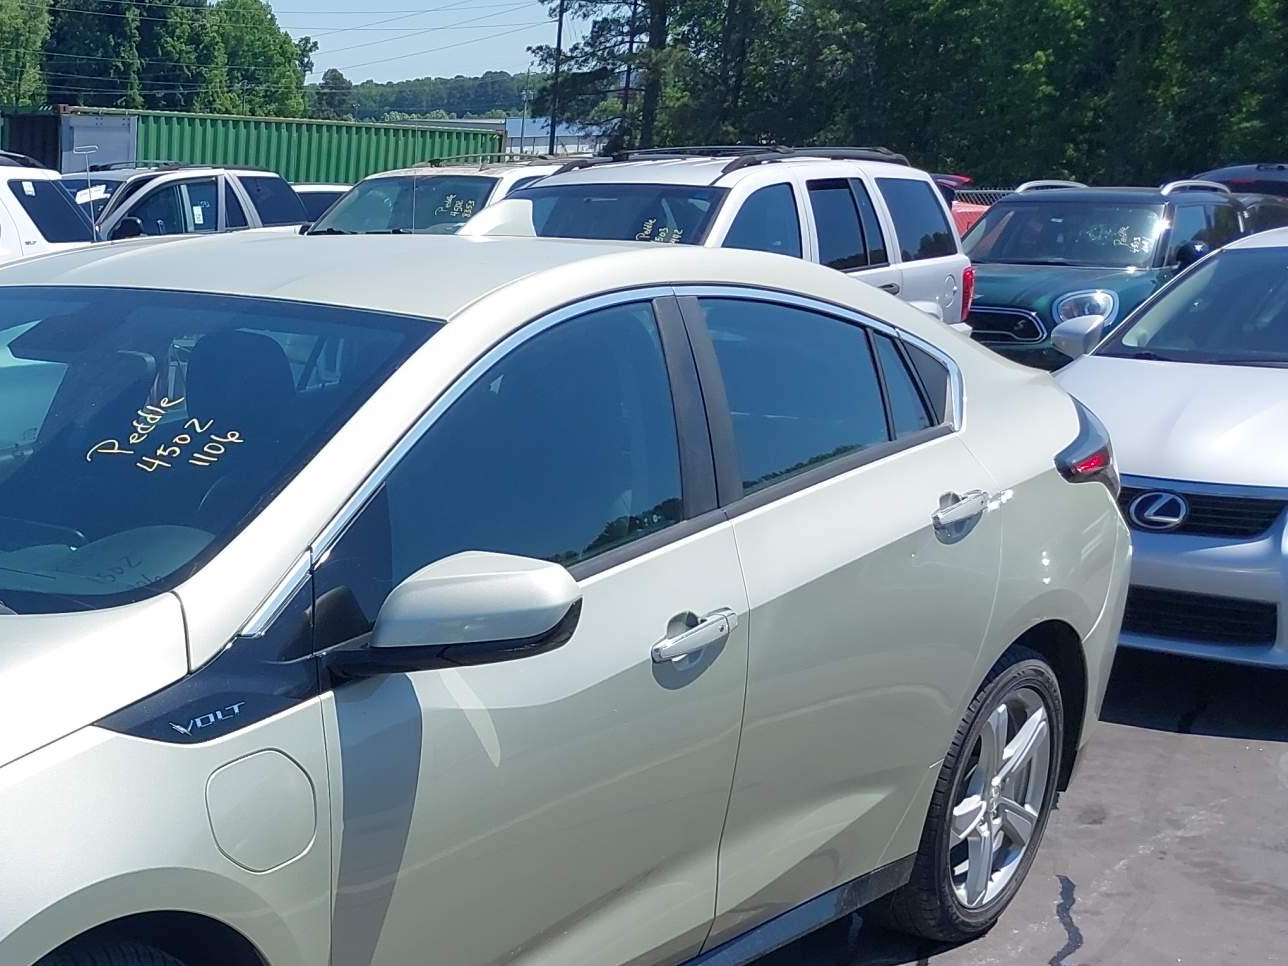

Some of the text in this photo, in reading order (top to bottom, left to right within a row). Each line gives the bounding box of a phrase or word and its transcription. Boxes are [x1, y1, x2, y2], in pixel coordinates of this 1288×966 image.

[86, 396, 185, 462] Peddle
[136, 417, 214, 472] 4502
[188, 431, 244, 466] 1106
[169, 701, 245, 737] VOLT
